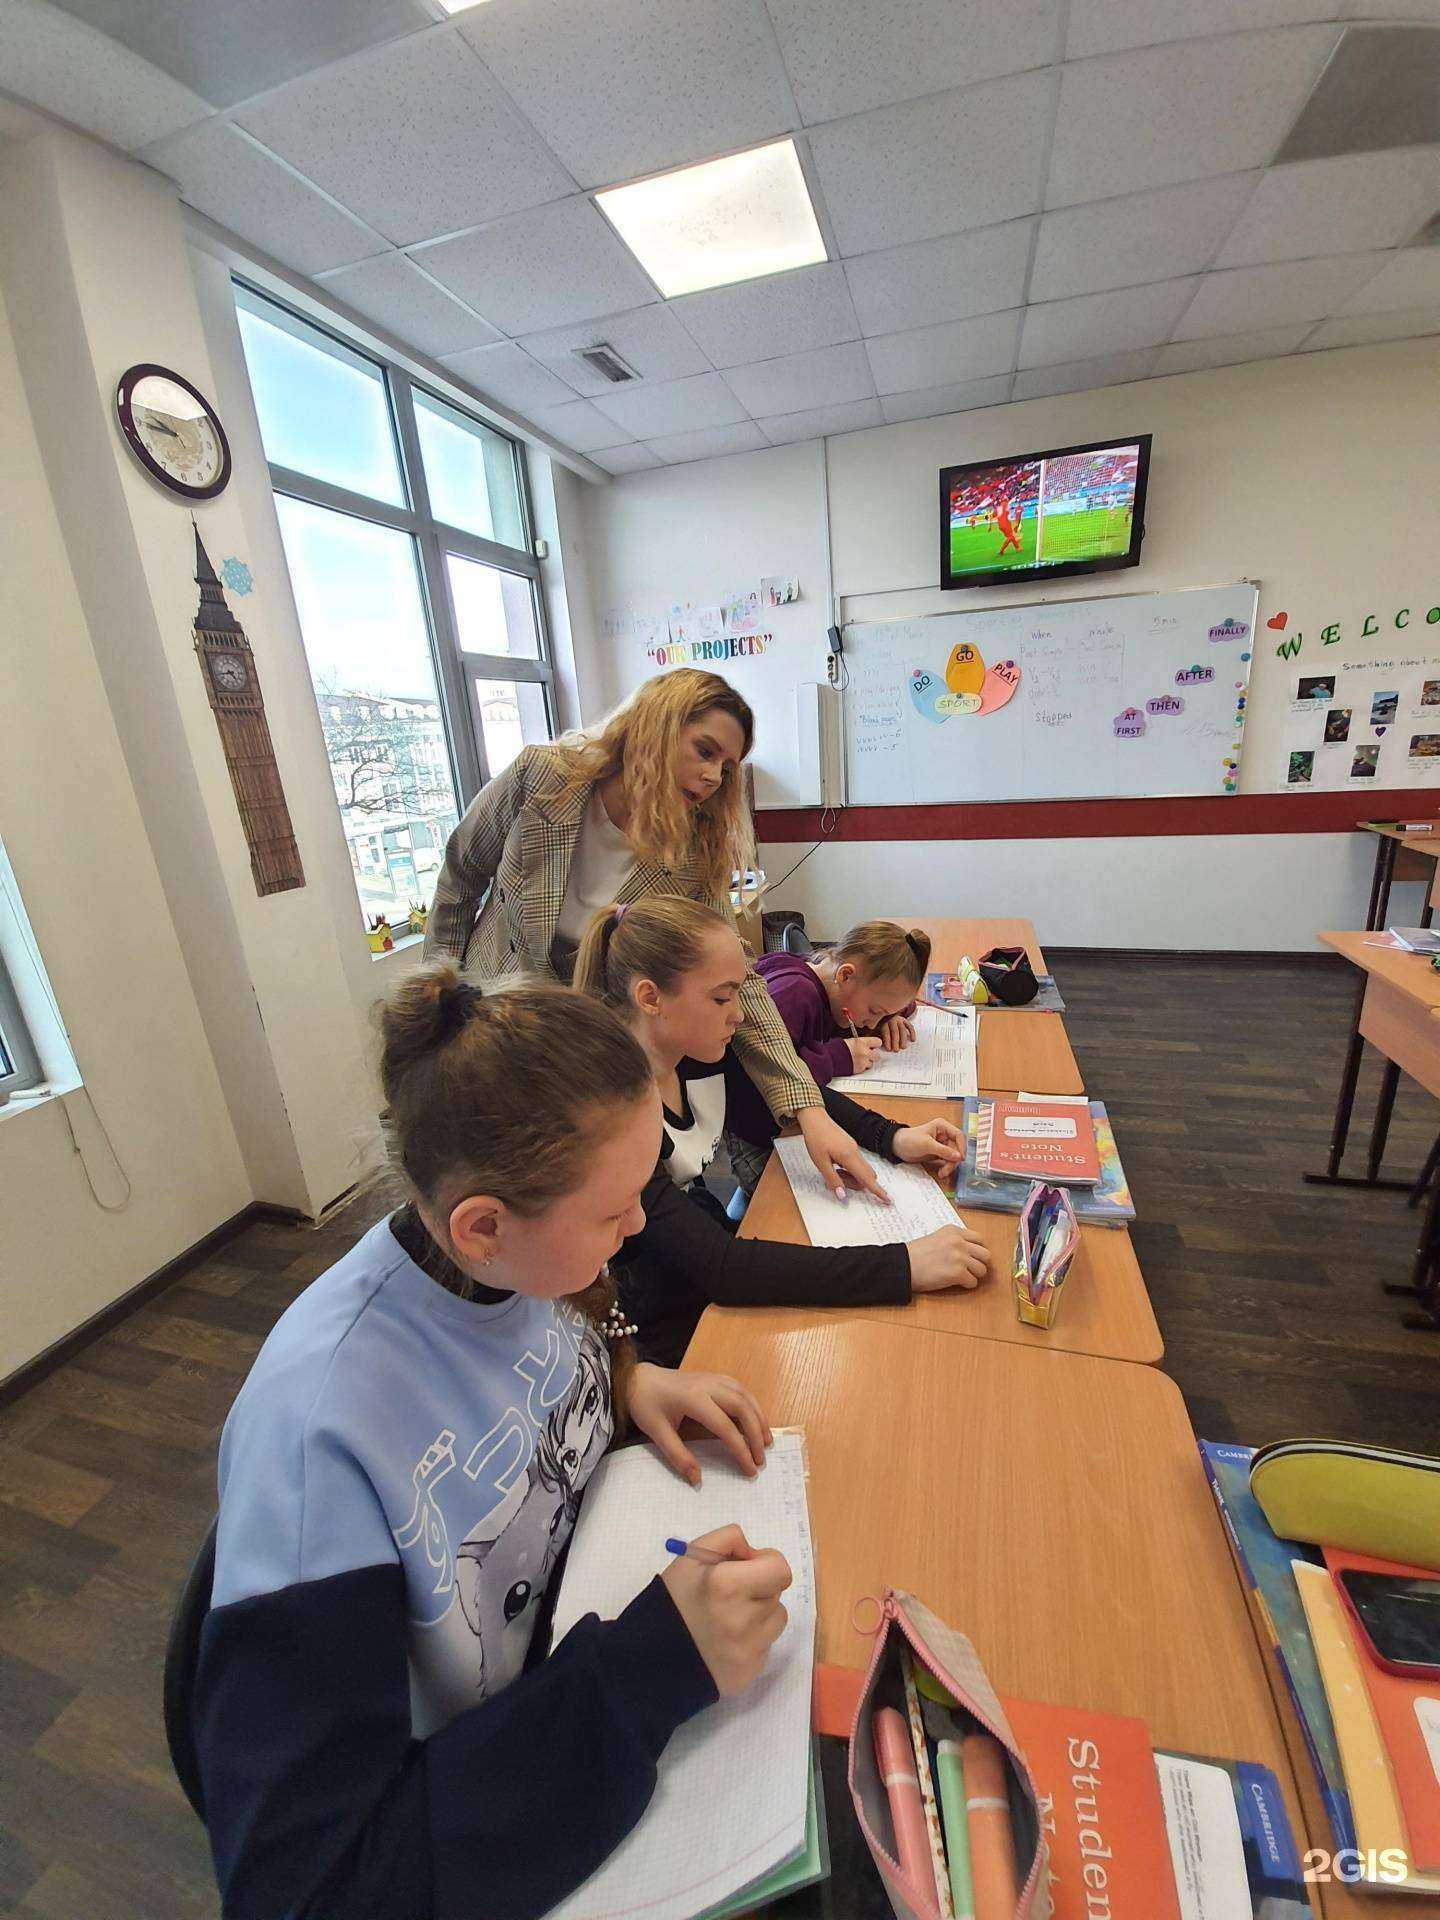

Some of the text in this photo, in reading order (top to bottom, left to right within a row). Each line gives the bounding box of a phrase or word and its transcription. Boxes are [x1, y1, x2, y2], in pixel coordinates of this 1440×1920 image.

[1209, 626, 1246, 637] FINALLY
[955, 650, 974, 662] GO
[993, 662, 1018, 684] PLAY
[1176, 669, 1213, 682] AFTER
[913, 675, 931, 692] DO
[937, 699, 978, 709] SPORT
[1150, 701, 1180, 711] THEN
[1124, 713, 1137, 721] AT
[1116, 727, 1142, 736] FIRST
[1021, 1143, 1063, 1152] Note
[1000, 1151, 1086, 1164] Student's
[1250, 1783, 1280, 1864] CAMBRIDGE
